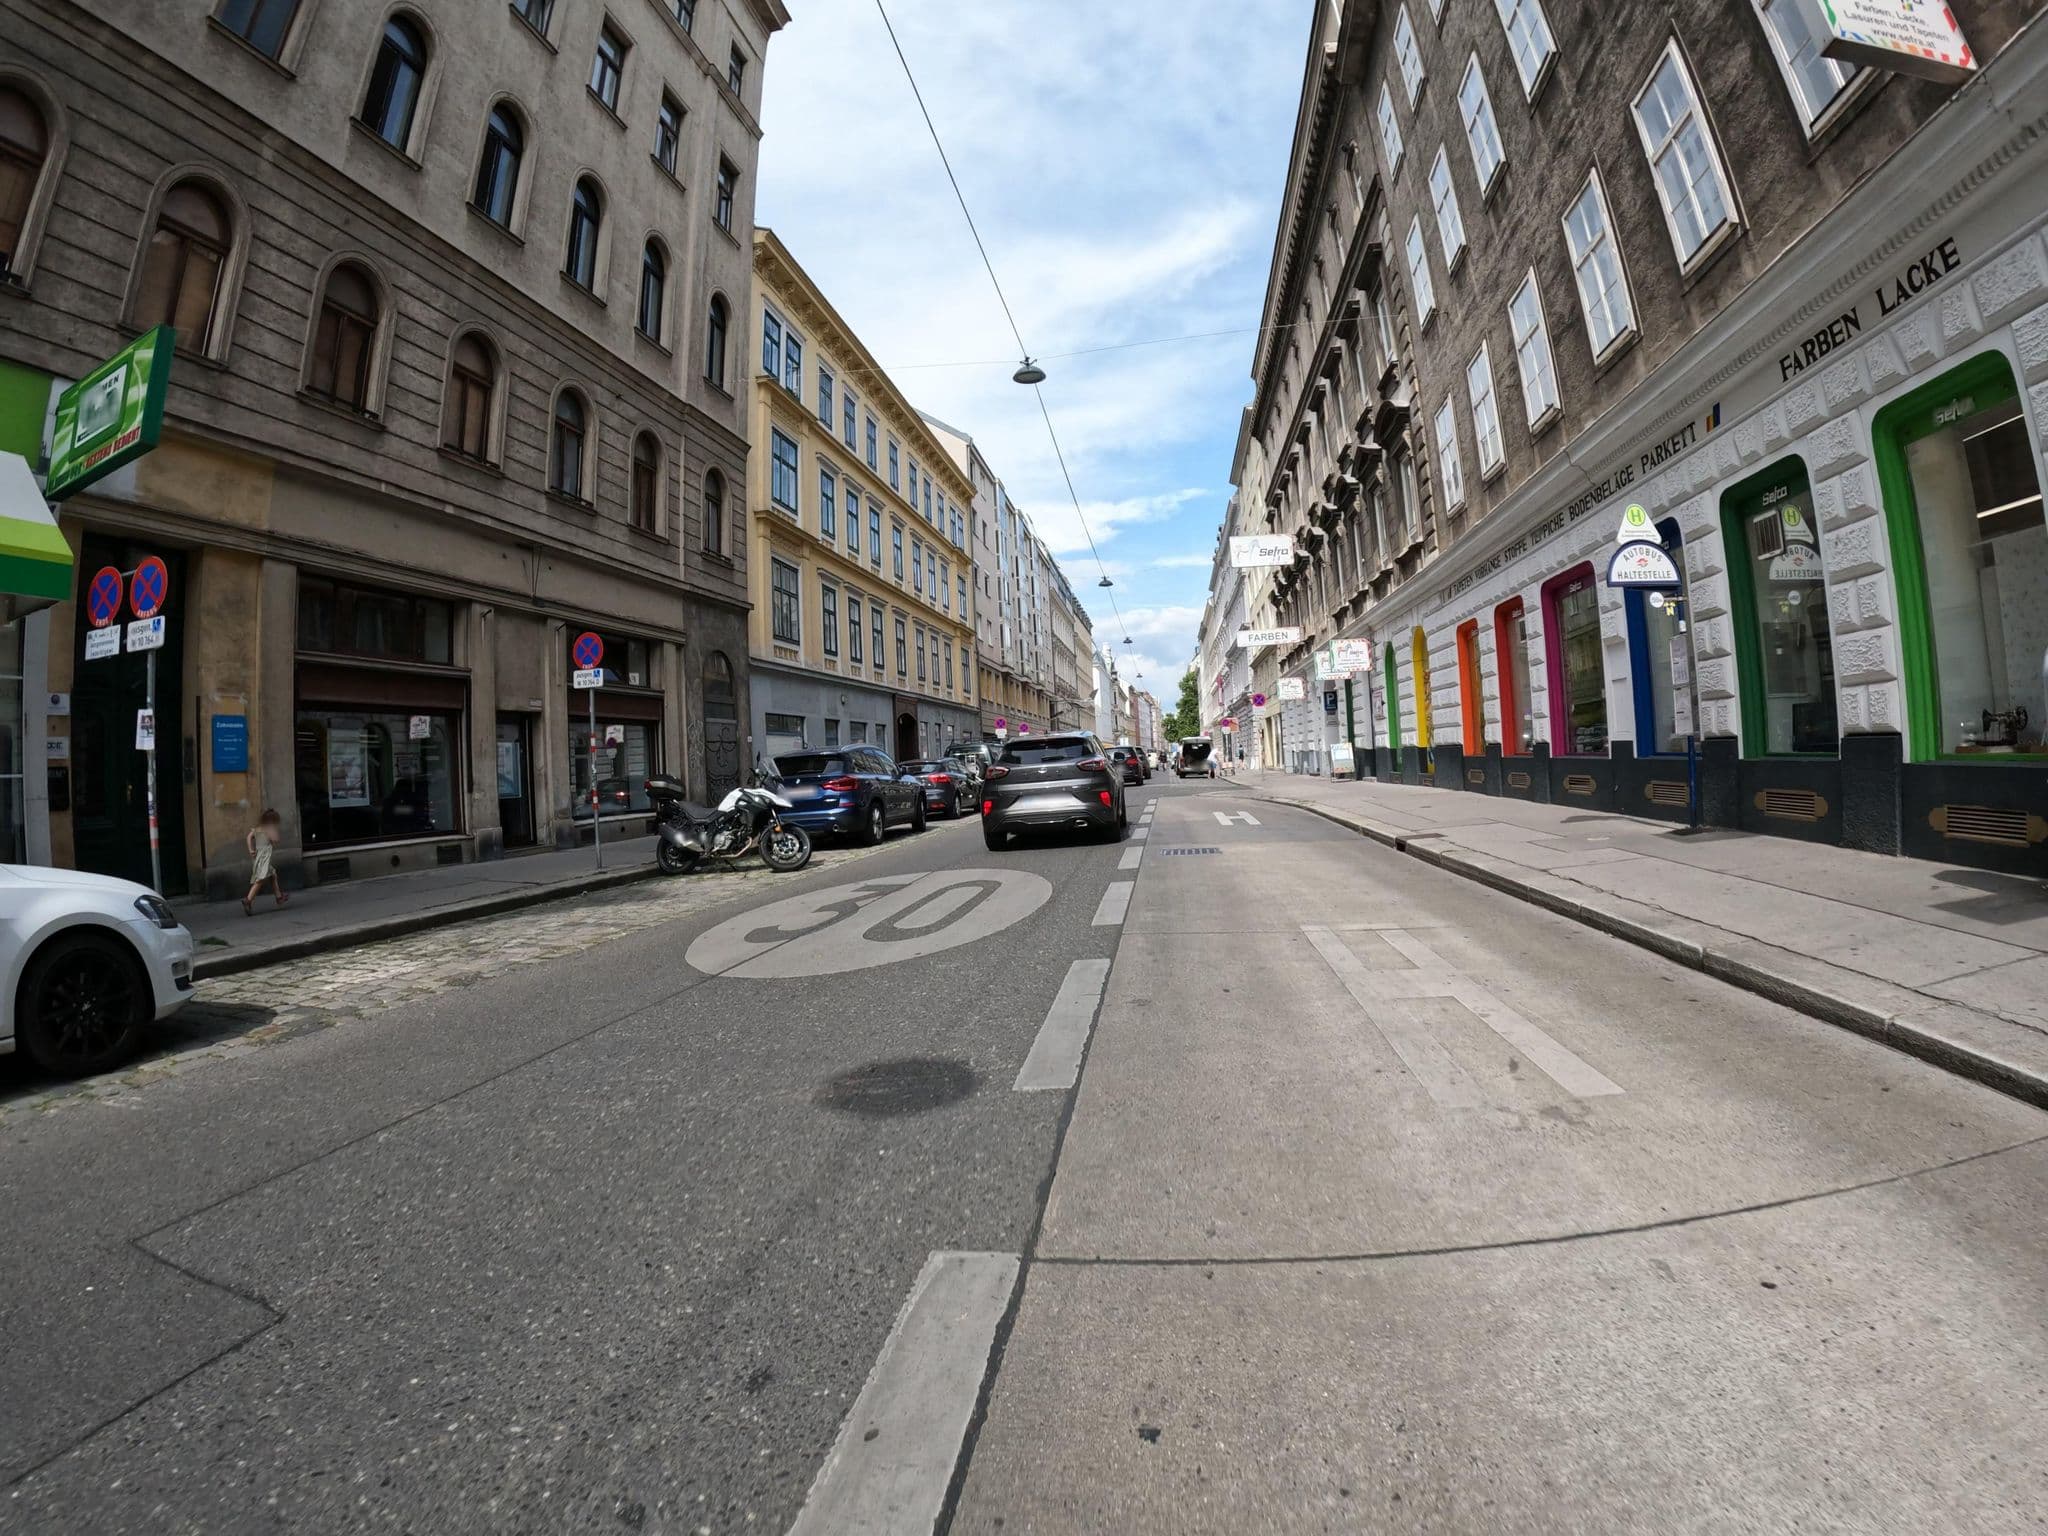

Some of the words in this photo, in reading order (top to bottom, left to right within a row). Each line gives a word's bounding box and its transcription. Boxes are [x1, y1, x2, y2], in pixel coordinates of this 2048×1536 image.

[1844, 10, 1887, 26] Lasuren
[1890, 22, 1909, 31] und
[1912, 25, 1950, 41] Tapeten
[1872, 28, 1937, 49] www.sefra.at
[1778, 306, 1861, 383] FARBEN
[1875, 236, 1961, 317] LACKE
[1504, 540, 1528, 562] STOFFE
[1568, 464, 1635, 522] BODENBELÄGE
[1640, 421, 1697, 475] PARKETT
[1631, 510, 1641, 522] H
[1259, 546, 1289, 558] Sefra
[1623, 547, 1662, 563] AUTOBUS
[1617, 570, 1672, 580] HALTESTELLE
[137, 605, 159, 618] ANFANG
[95, 617, 109, 627] ENDE
[1248, 631, 1289, 643] FARBEN
[744, 879, 1002, 943] 30
